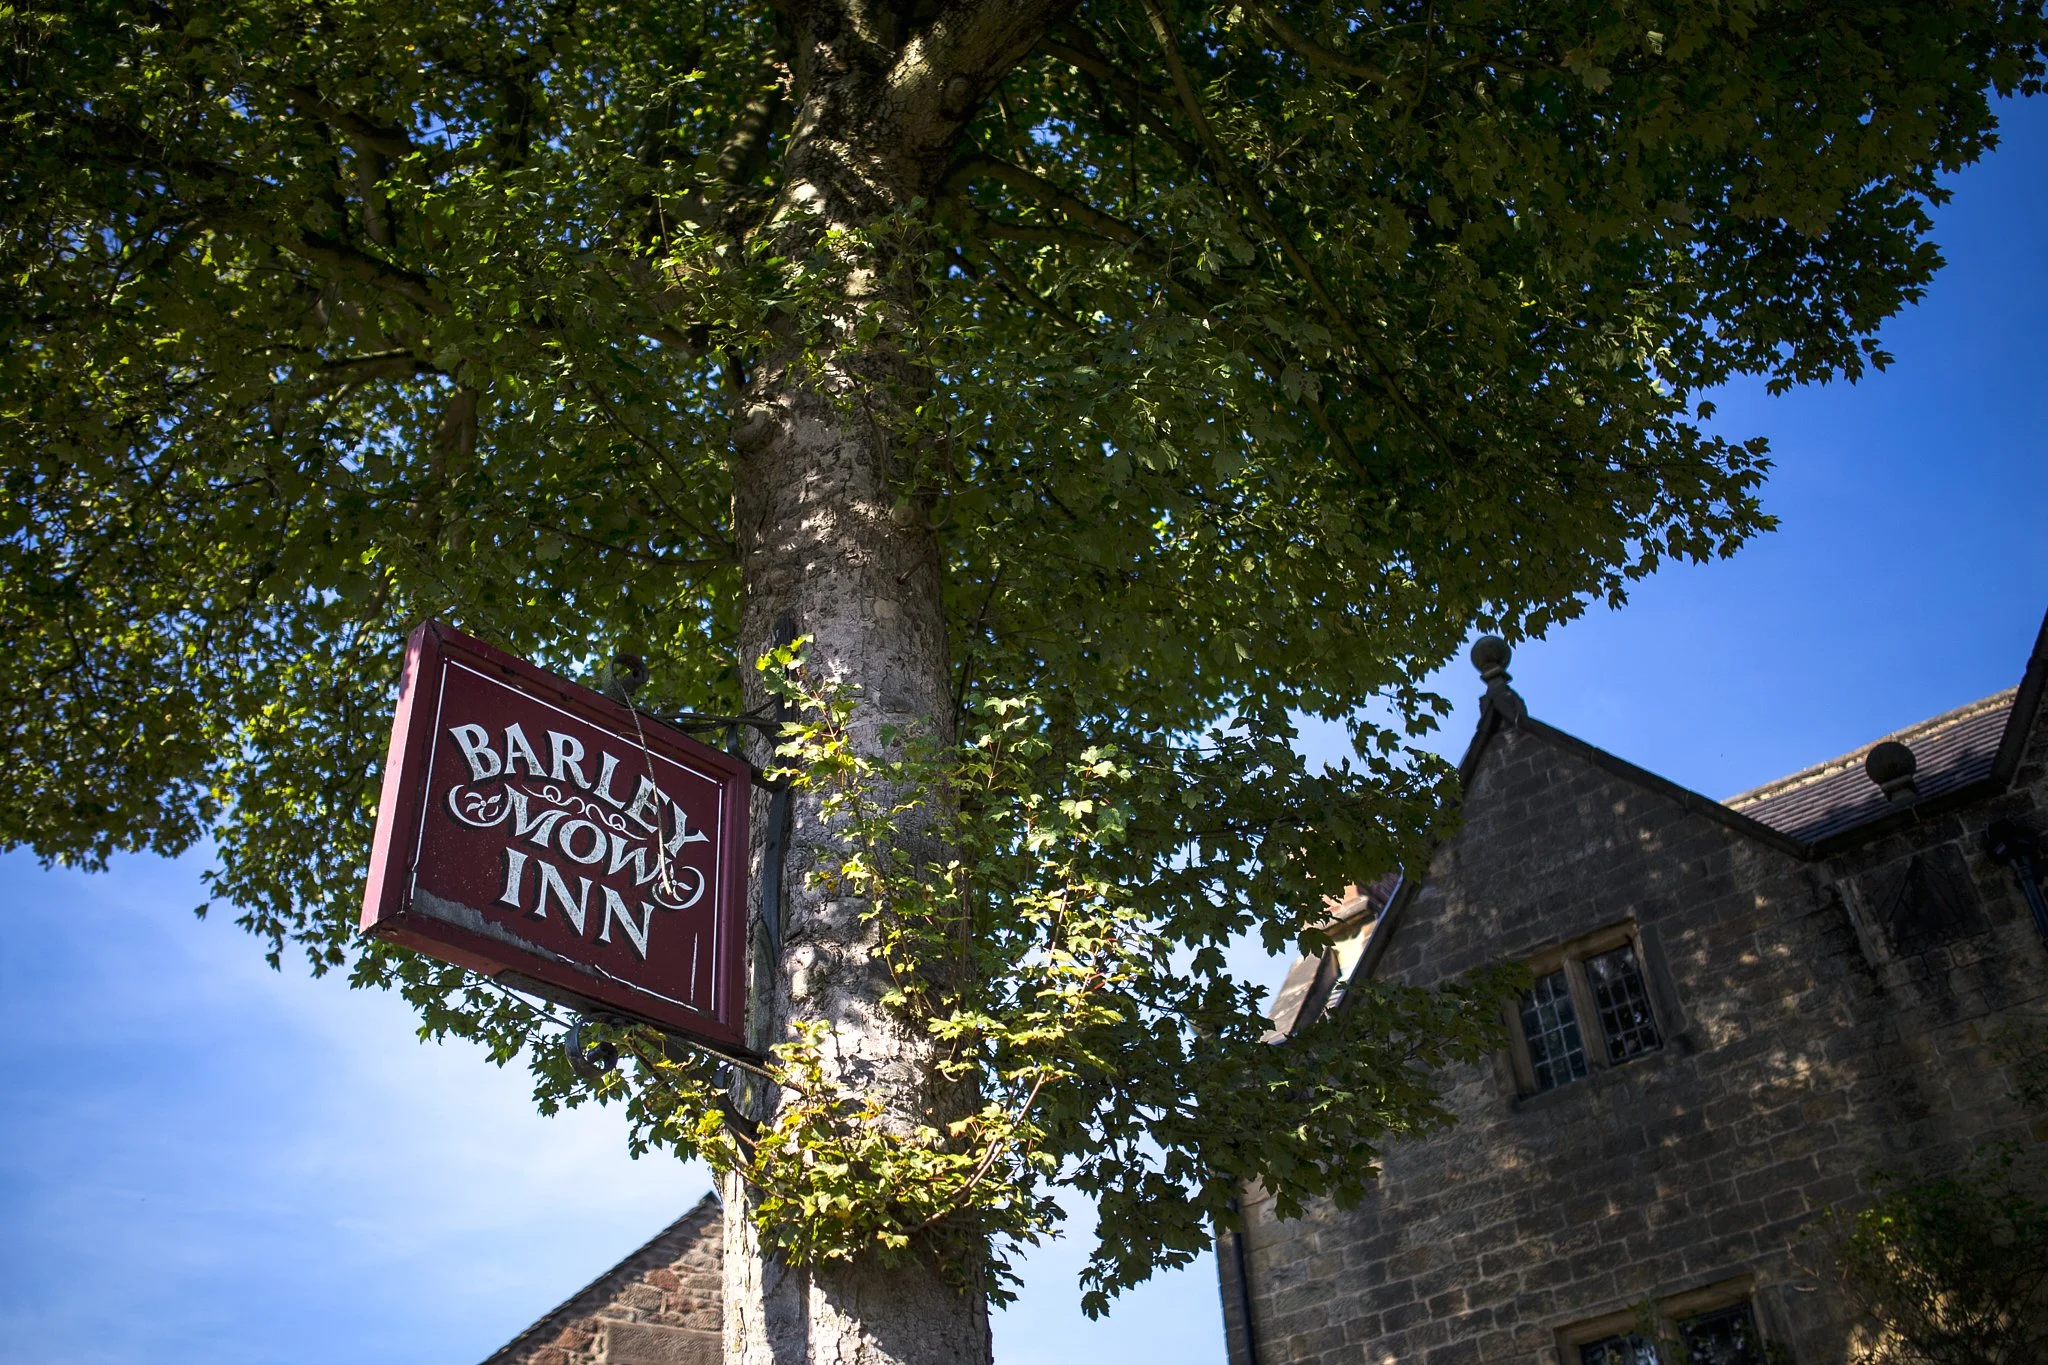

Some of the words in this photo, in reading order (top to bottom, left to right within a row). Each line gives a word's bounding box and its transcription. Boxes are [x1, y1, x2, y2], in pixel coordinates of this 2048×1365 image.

[449, 722, 710, 857] BARLEY
[503, 783, 672, 886] MOW
[500, 846, 655, 961] INN
